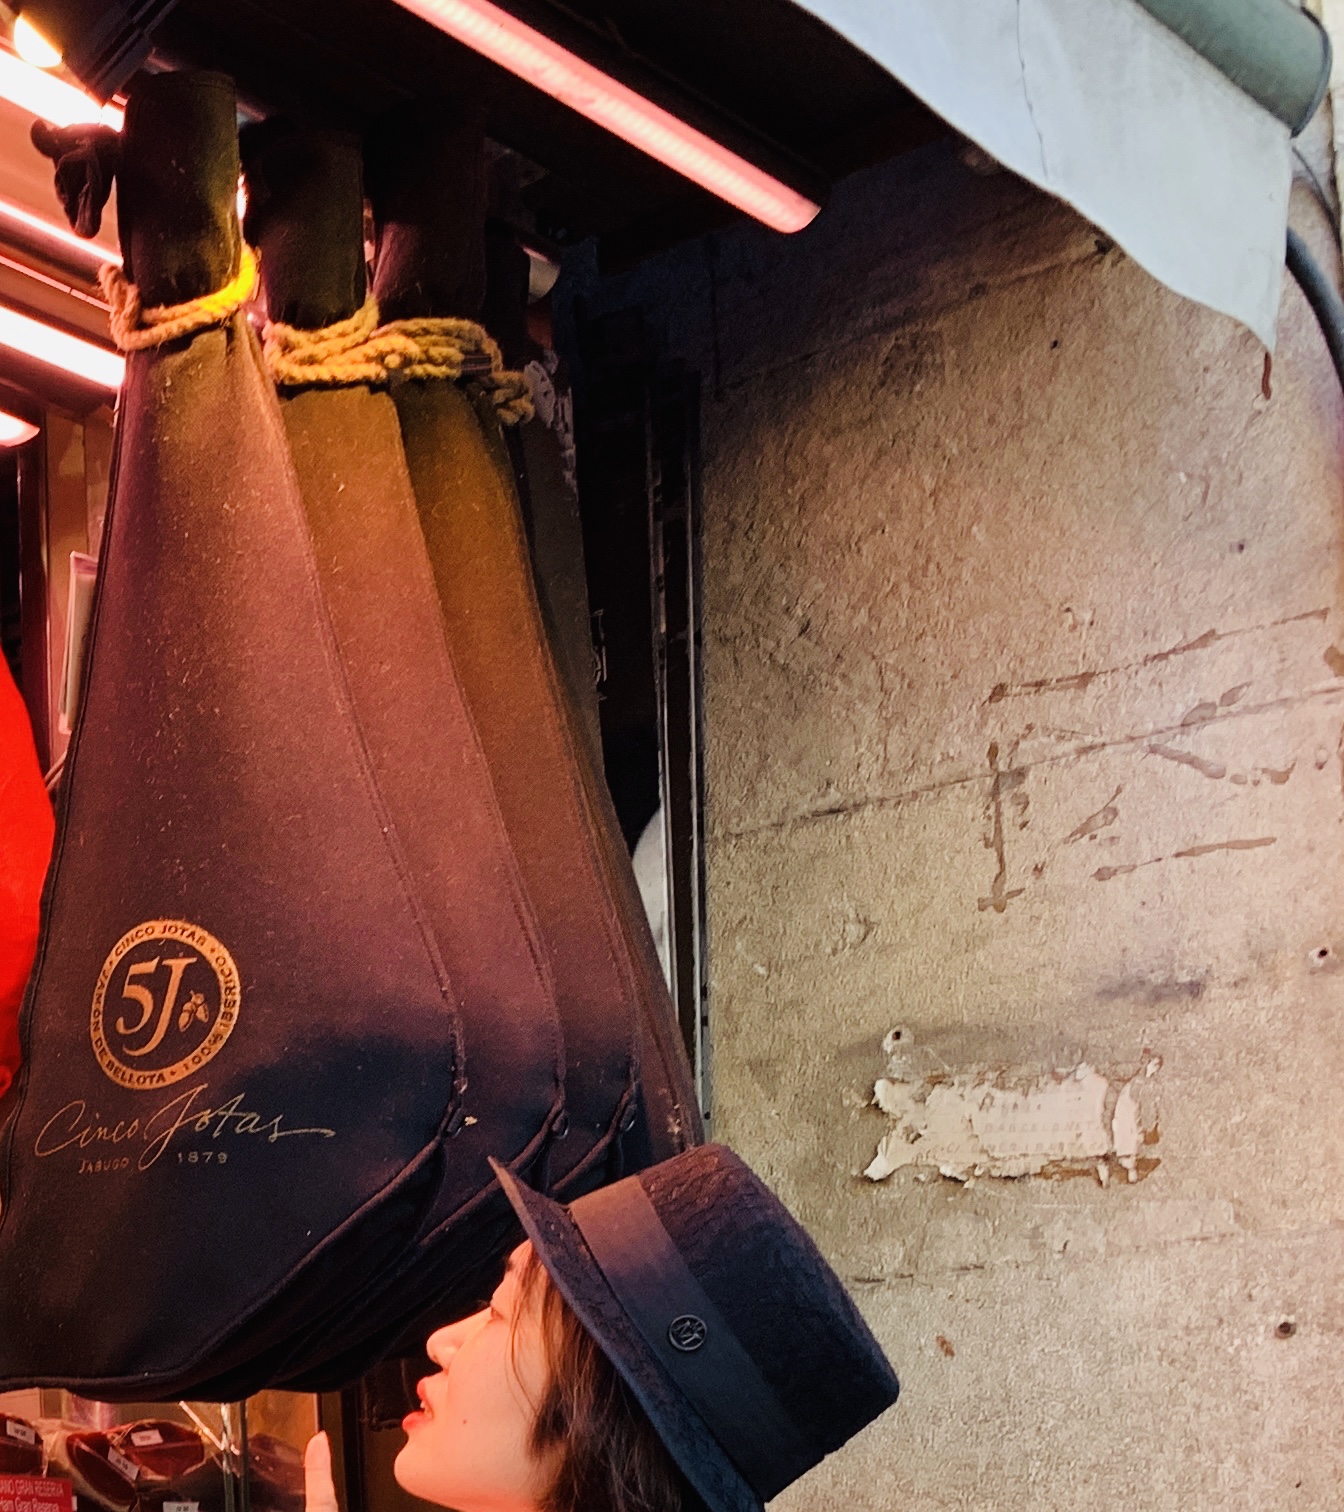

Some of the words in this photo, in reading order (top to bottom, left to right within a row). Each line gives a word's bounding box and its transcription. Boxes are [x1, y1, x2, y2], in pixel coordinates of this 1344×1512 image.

[114, 925, 155, 956] CINCO
[116, 956, 197, 1056] 5J
[106, 1061, 166, 1085] BELLOTA
[35, 1101, 140, 1156] Cinco
[138, 1084, 336, 1170] Jotas
[78, 1157, 129, 1174] JABUGO
[178, 1152, 228, 1164] 1879
[15, 1479, 34, 1496] GRAN
[34, 1481, 64, 1498] RESERVA
